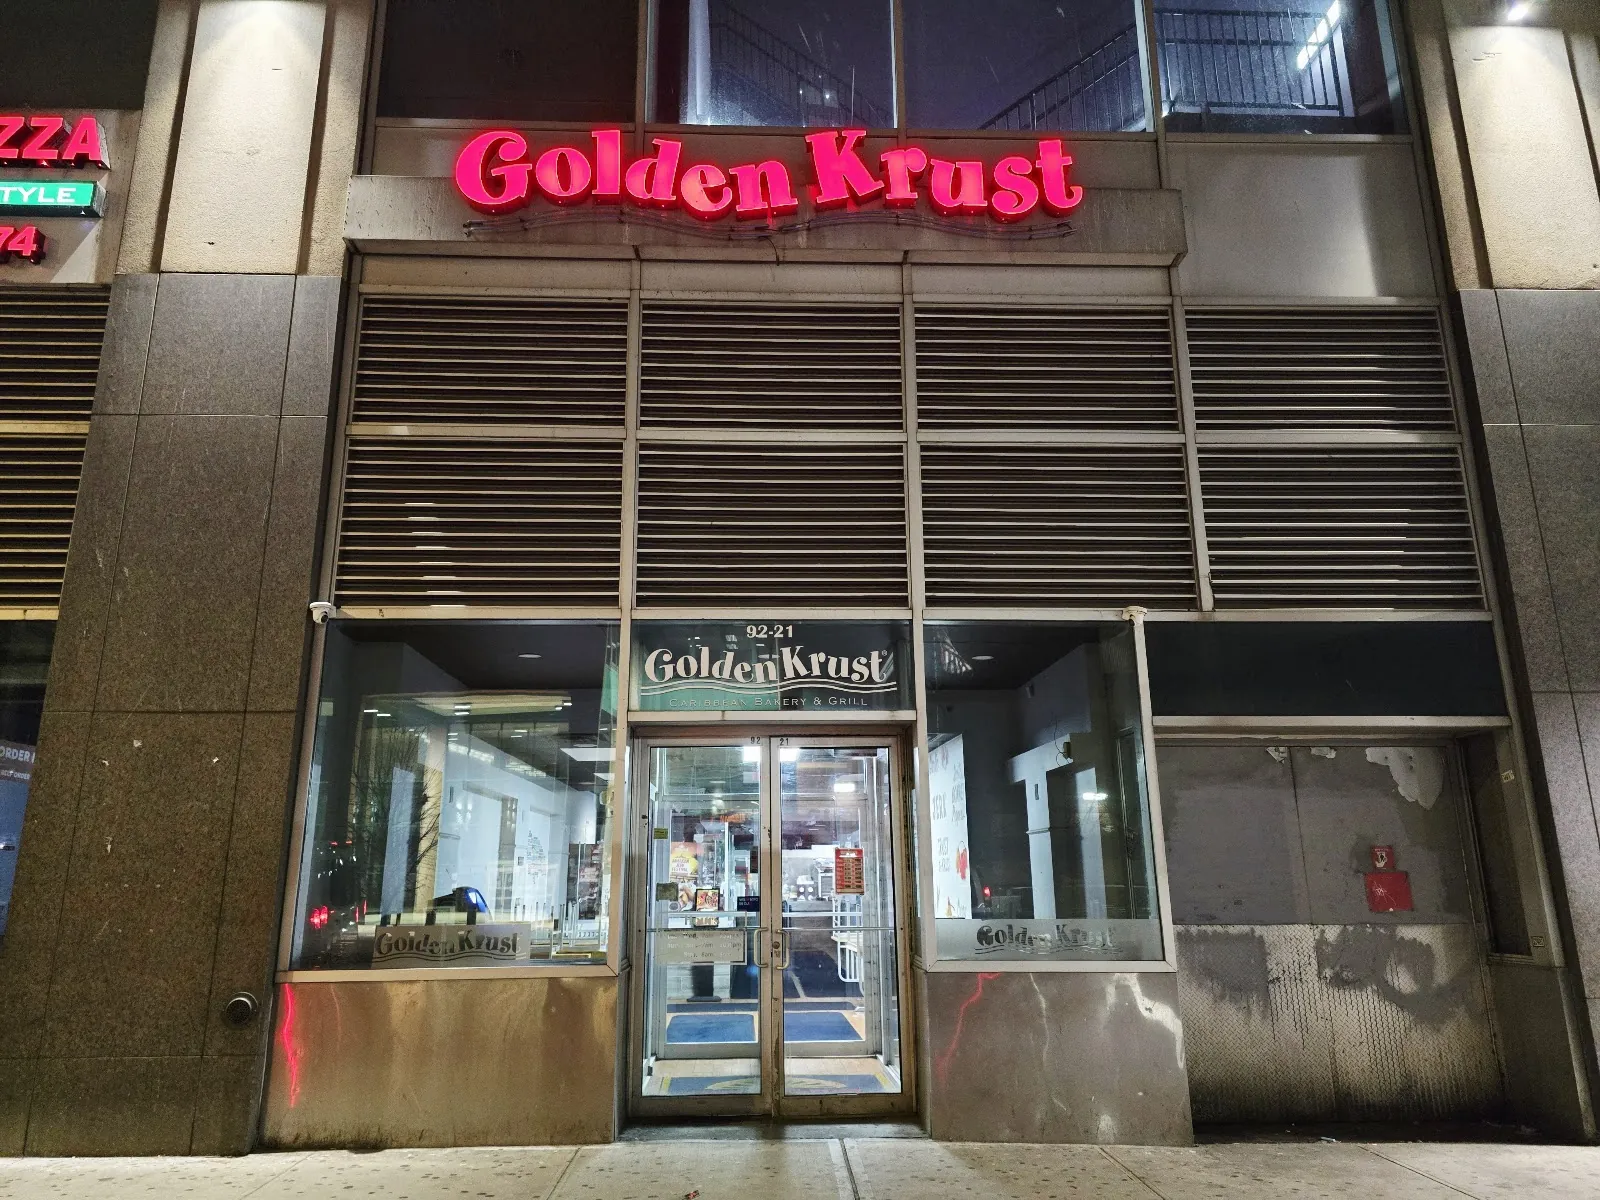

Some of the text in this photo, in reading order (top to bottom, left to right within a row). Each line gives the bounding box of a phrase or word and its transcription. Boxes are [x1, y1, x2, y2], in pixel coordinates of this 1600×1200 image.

[455, 129, 1084, 213] Golden Krust
[746, 625, 793, 638] 92-21
[644, 646, 779, 683] Golden
[814, 697, 822, 705] &
[750, 736, 789, 746] 92 21
